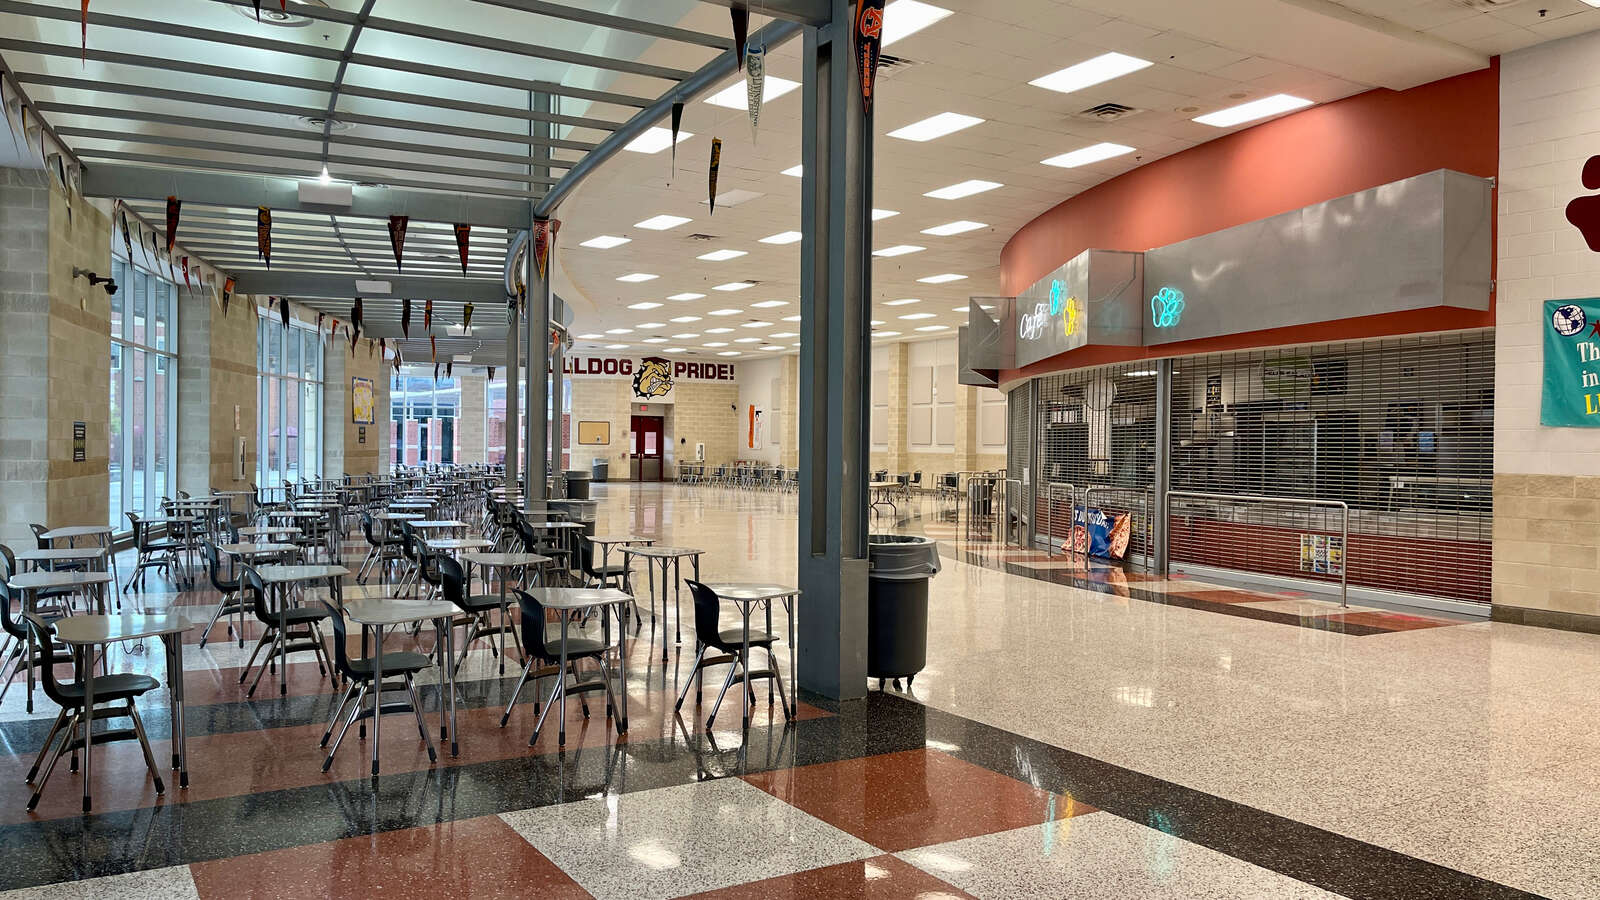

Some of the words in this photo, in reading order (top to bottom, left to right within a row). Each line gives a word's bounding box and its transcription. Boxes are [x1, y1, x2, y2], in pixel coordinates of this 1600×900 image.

[1576, 341, 1600, 363] Th
[562, 357, 633, 375] LLDOG
[674, 361, 735, 380] PRIDE!
[1581, 370, 1600, 388] in
